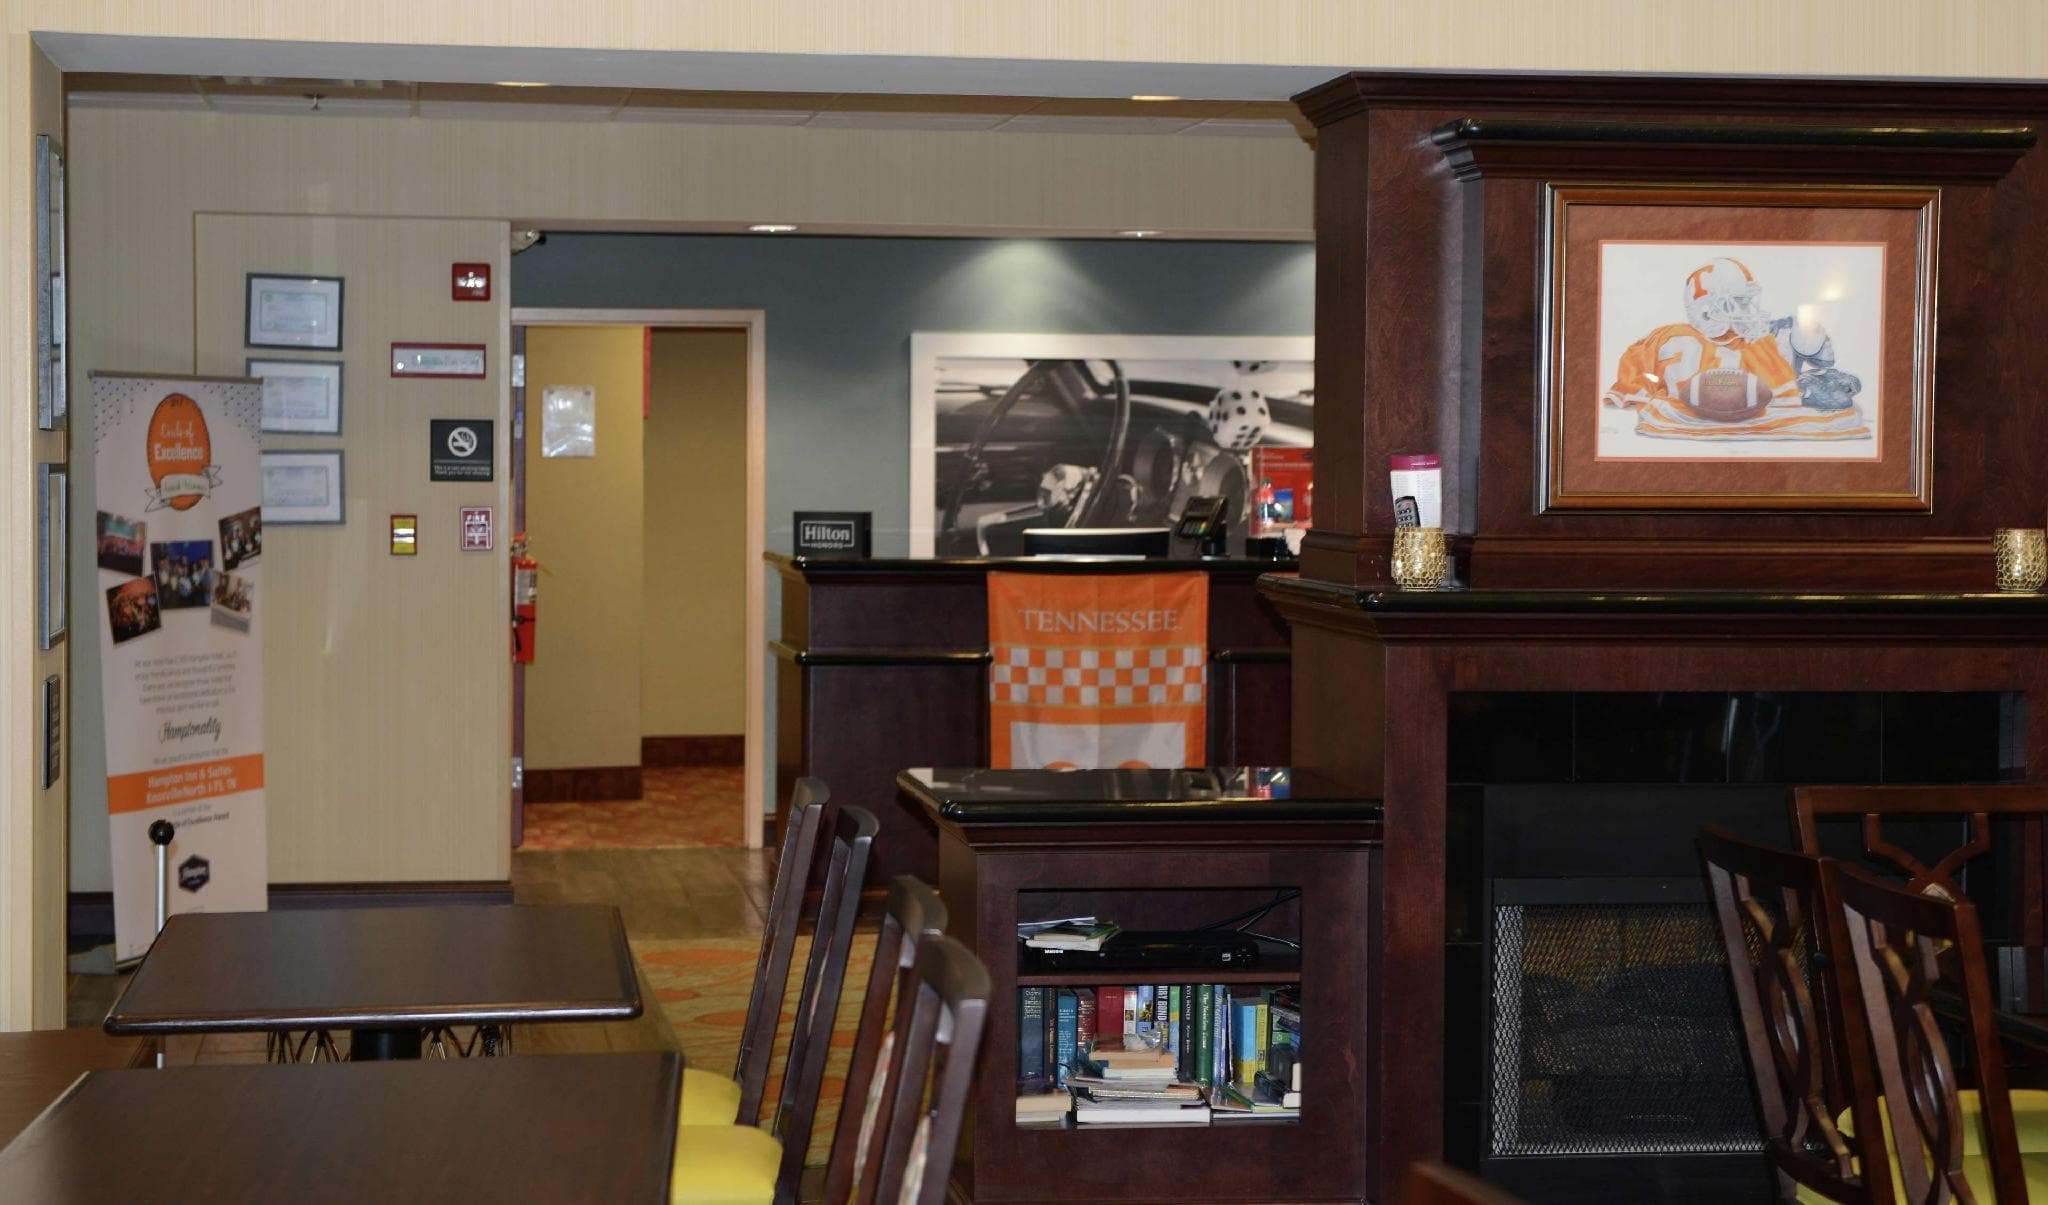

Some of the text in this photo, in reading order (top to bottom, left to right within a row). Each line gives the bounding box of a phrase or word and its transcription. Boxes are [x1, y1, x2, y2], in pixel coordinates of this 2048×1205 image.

[153, 442, 204, 462] Excellence
[804, 526, 850, 541] Hilton
[1018, 608, 1180, 634] TENNESSEE
[158, 716, 222, 744] Hamptonality
[1157, 1001, 1168, 1021] BOND
